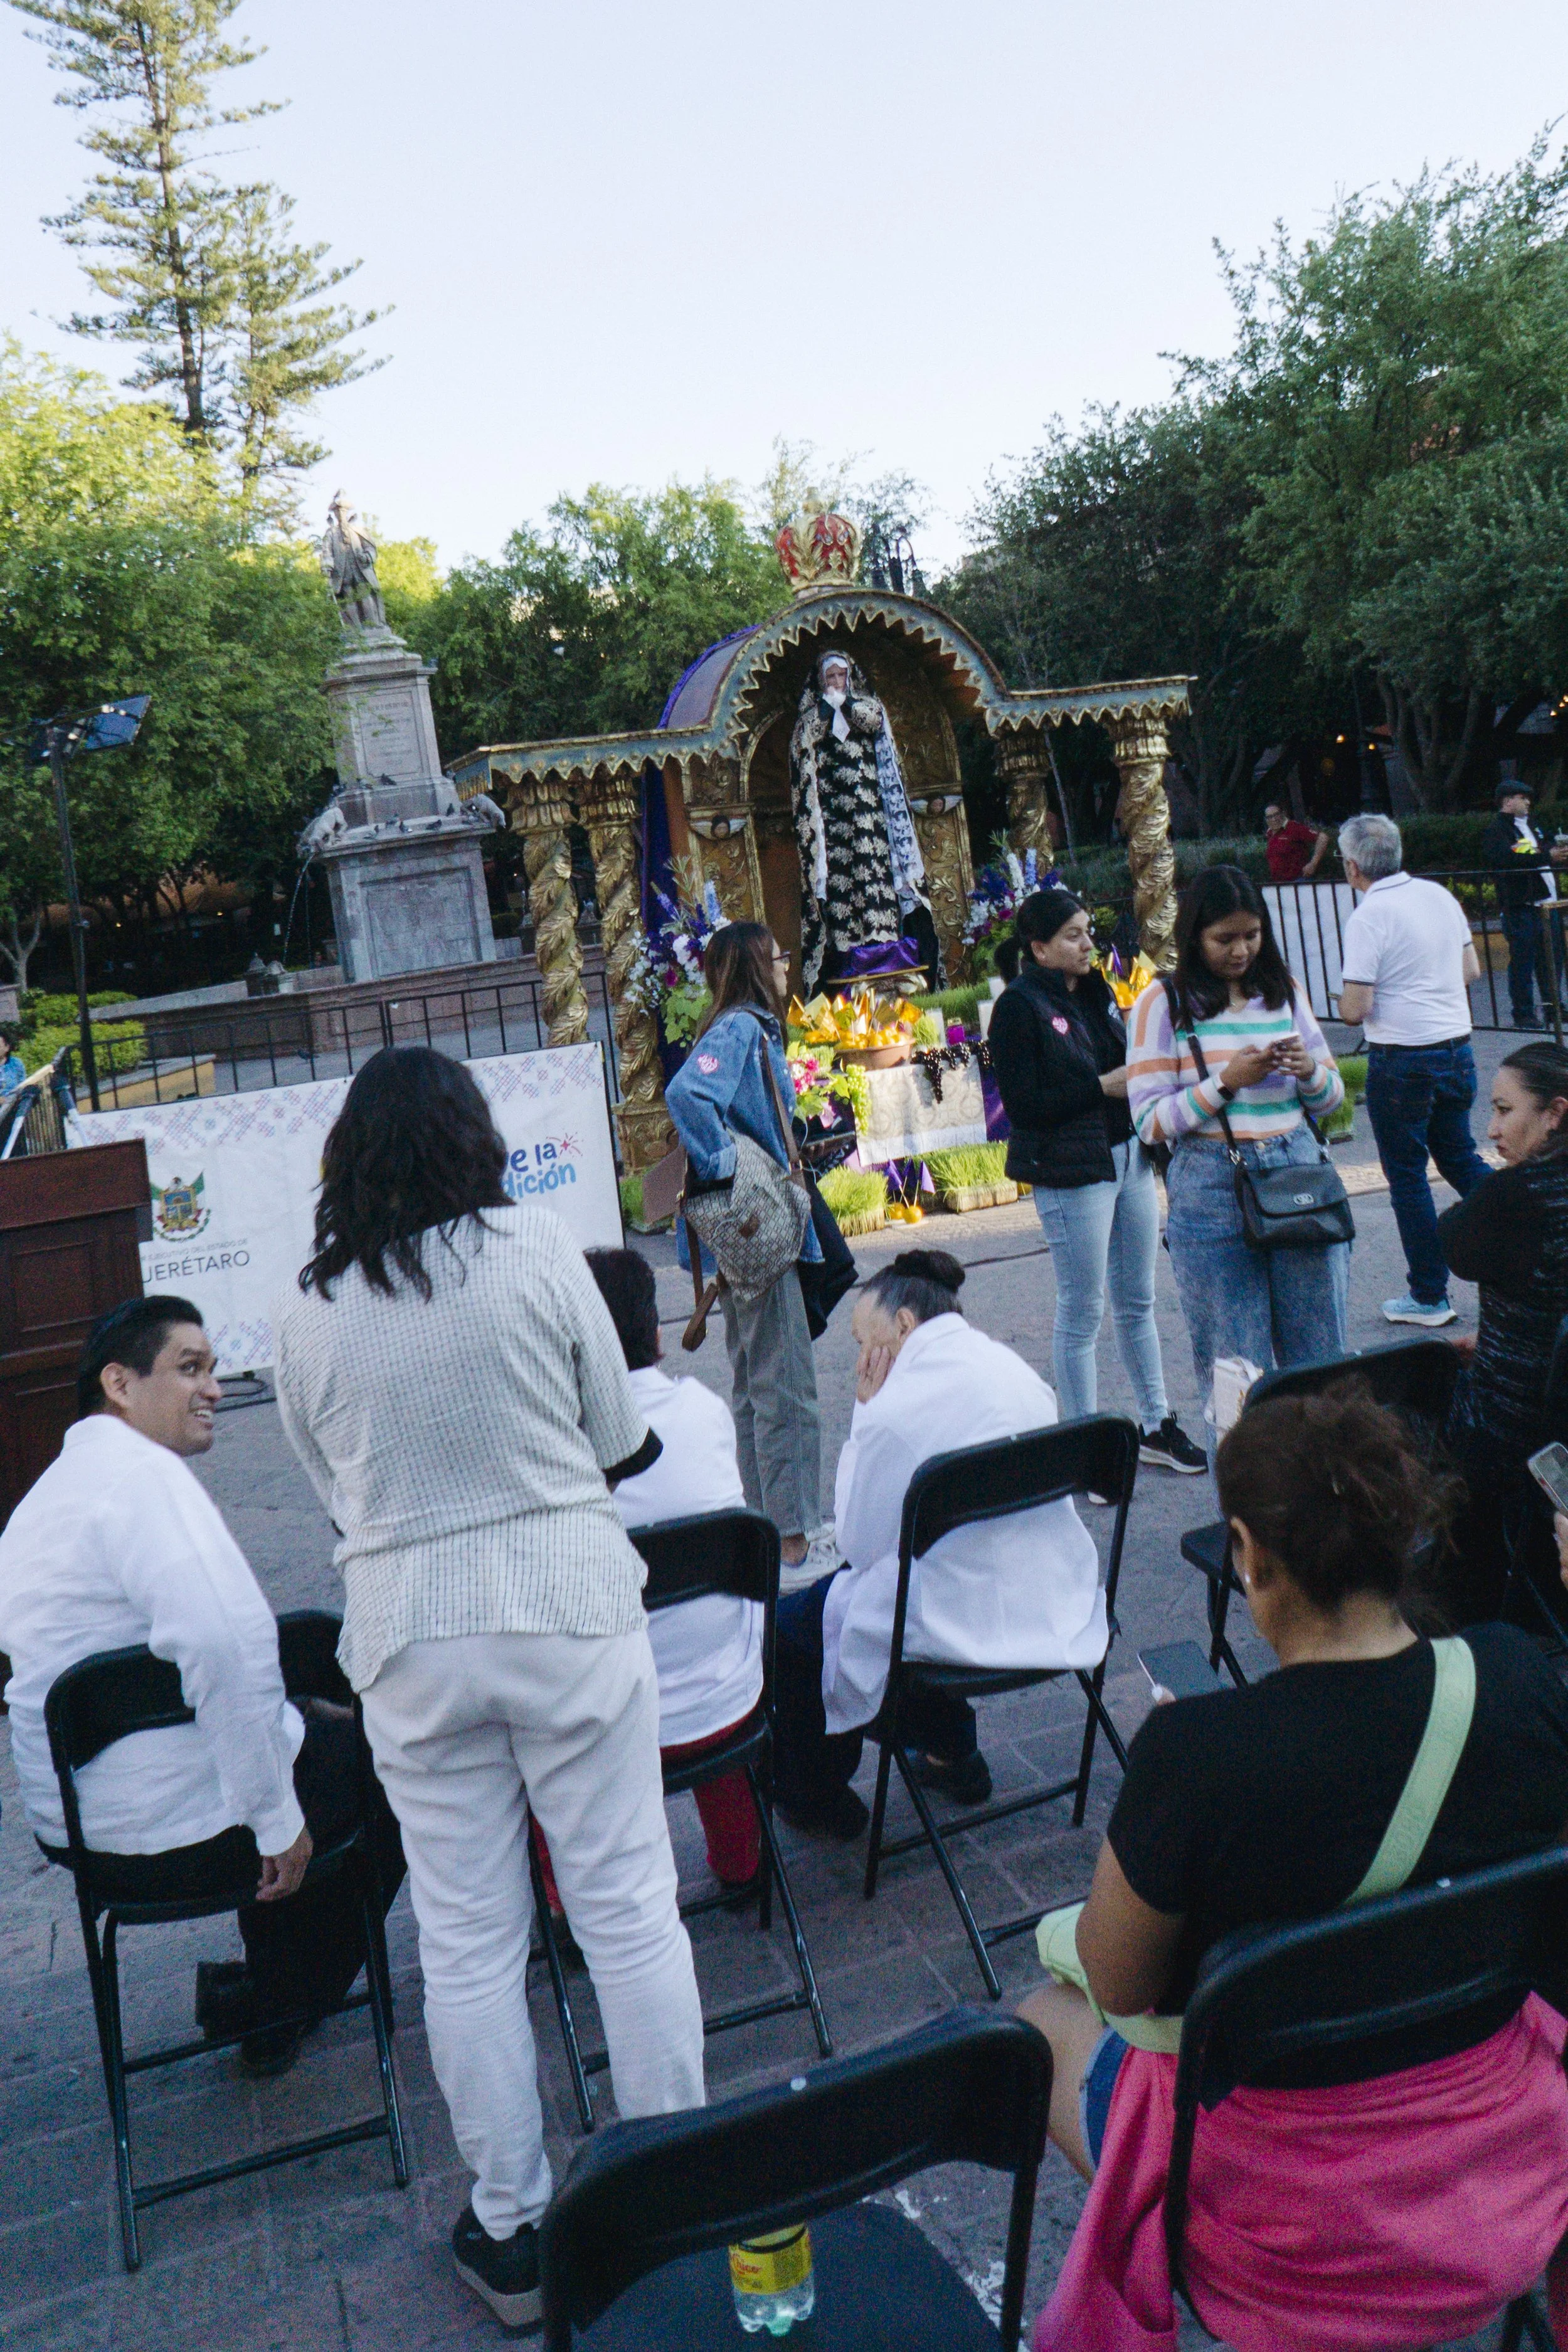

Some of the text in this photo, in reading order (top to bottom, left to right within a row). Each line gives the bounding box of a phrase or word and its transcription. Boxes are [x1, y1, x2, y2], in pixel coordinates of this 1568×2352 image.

[535, 1143, 557, 1166] la
[501, 1162, 576, 1199] dición
[142, 1250, 250, 1283] UERÉTARO
